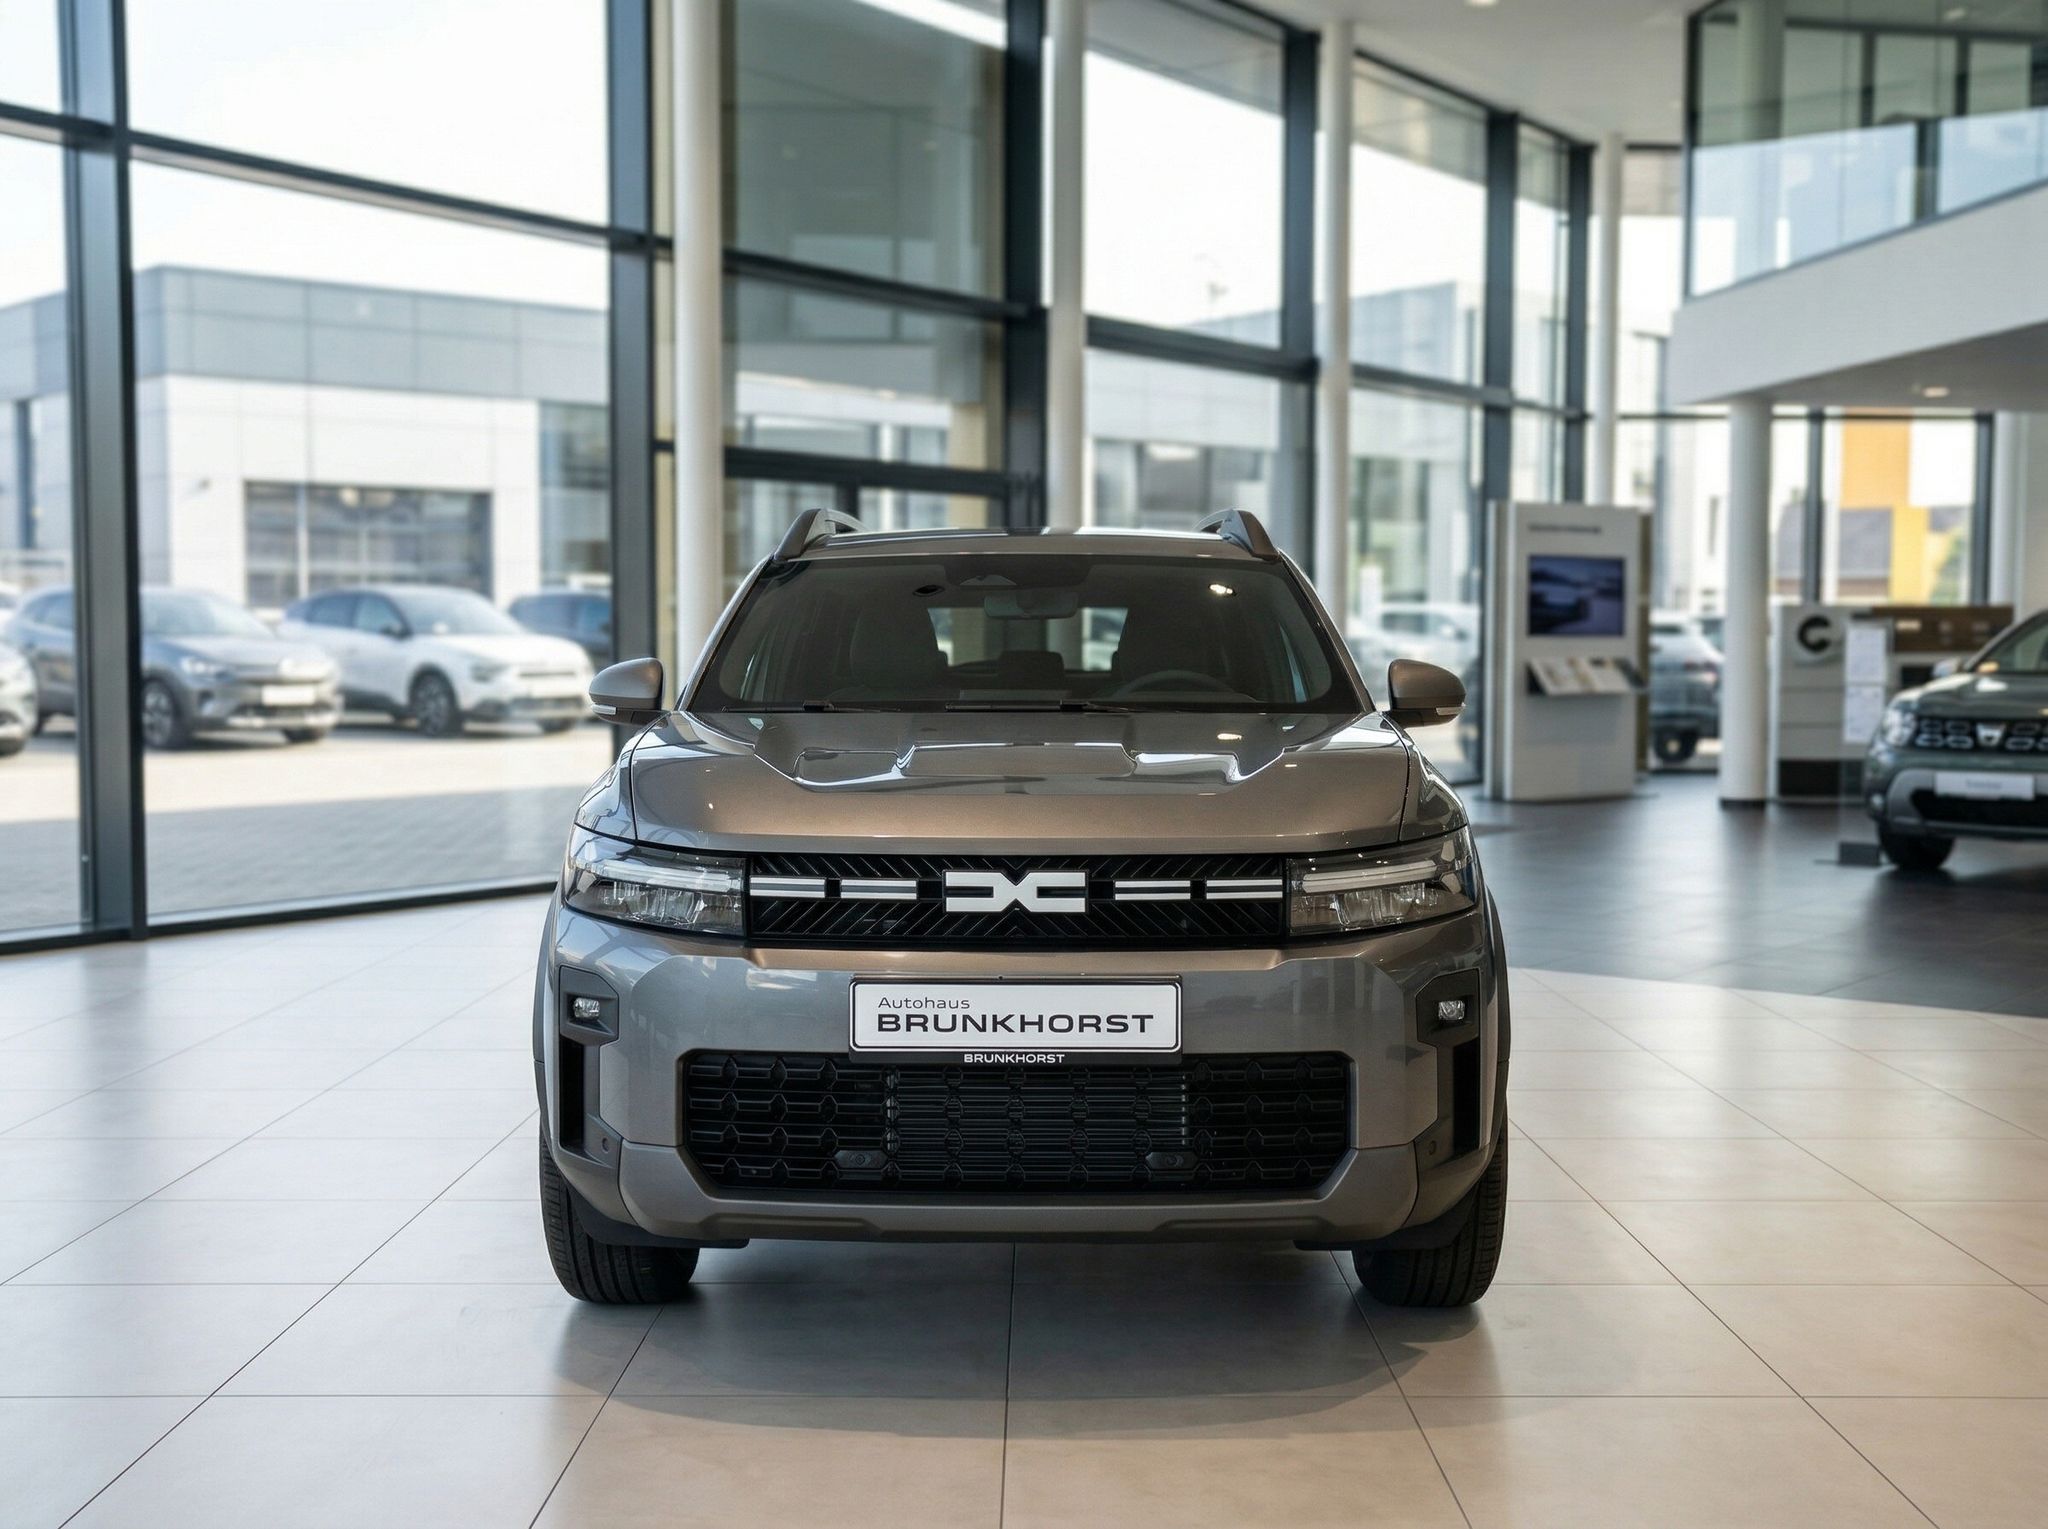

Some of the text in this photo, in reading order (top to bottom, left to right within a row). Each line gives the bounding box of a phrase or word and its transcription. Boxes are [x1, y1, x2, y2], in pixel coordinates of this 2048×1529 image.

[877, 996, 970, 1010] Autohaus
[877, 1013, 1154, 1034] BRUNKHORST
[963, 1053, 1066, 1064] BRUNKHORST
